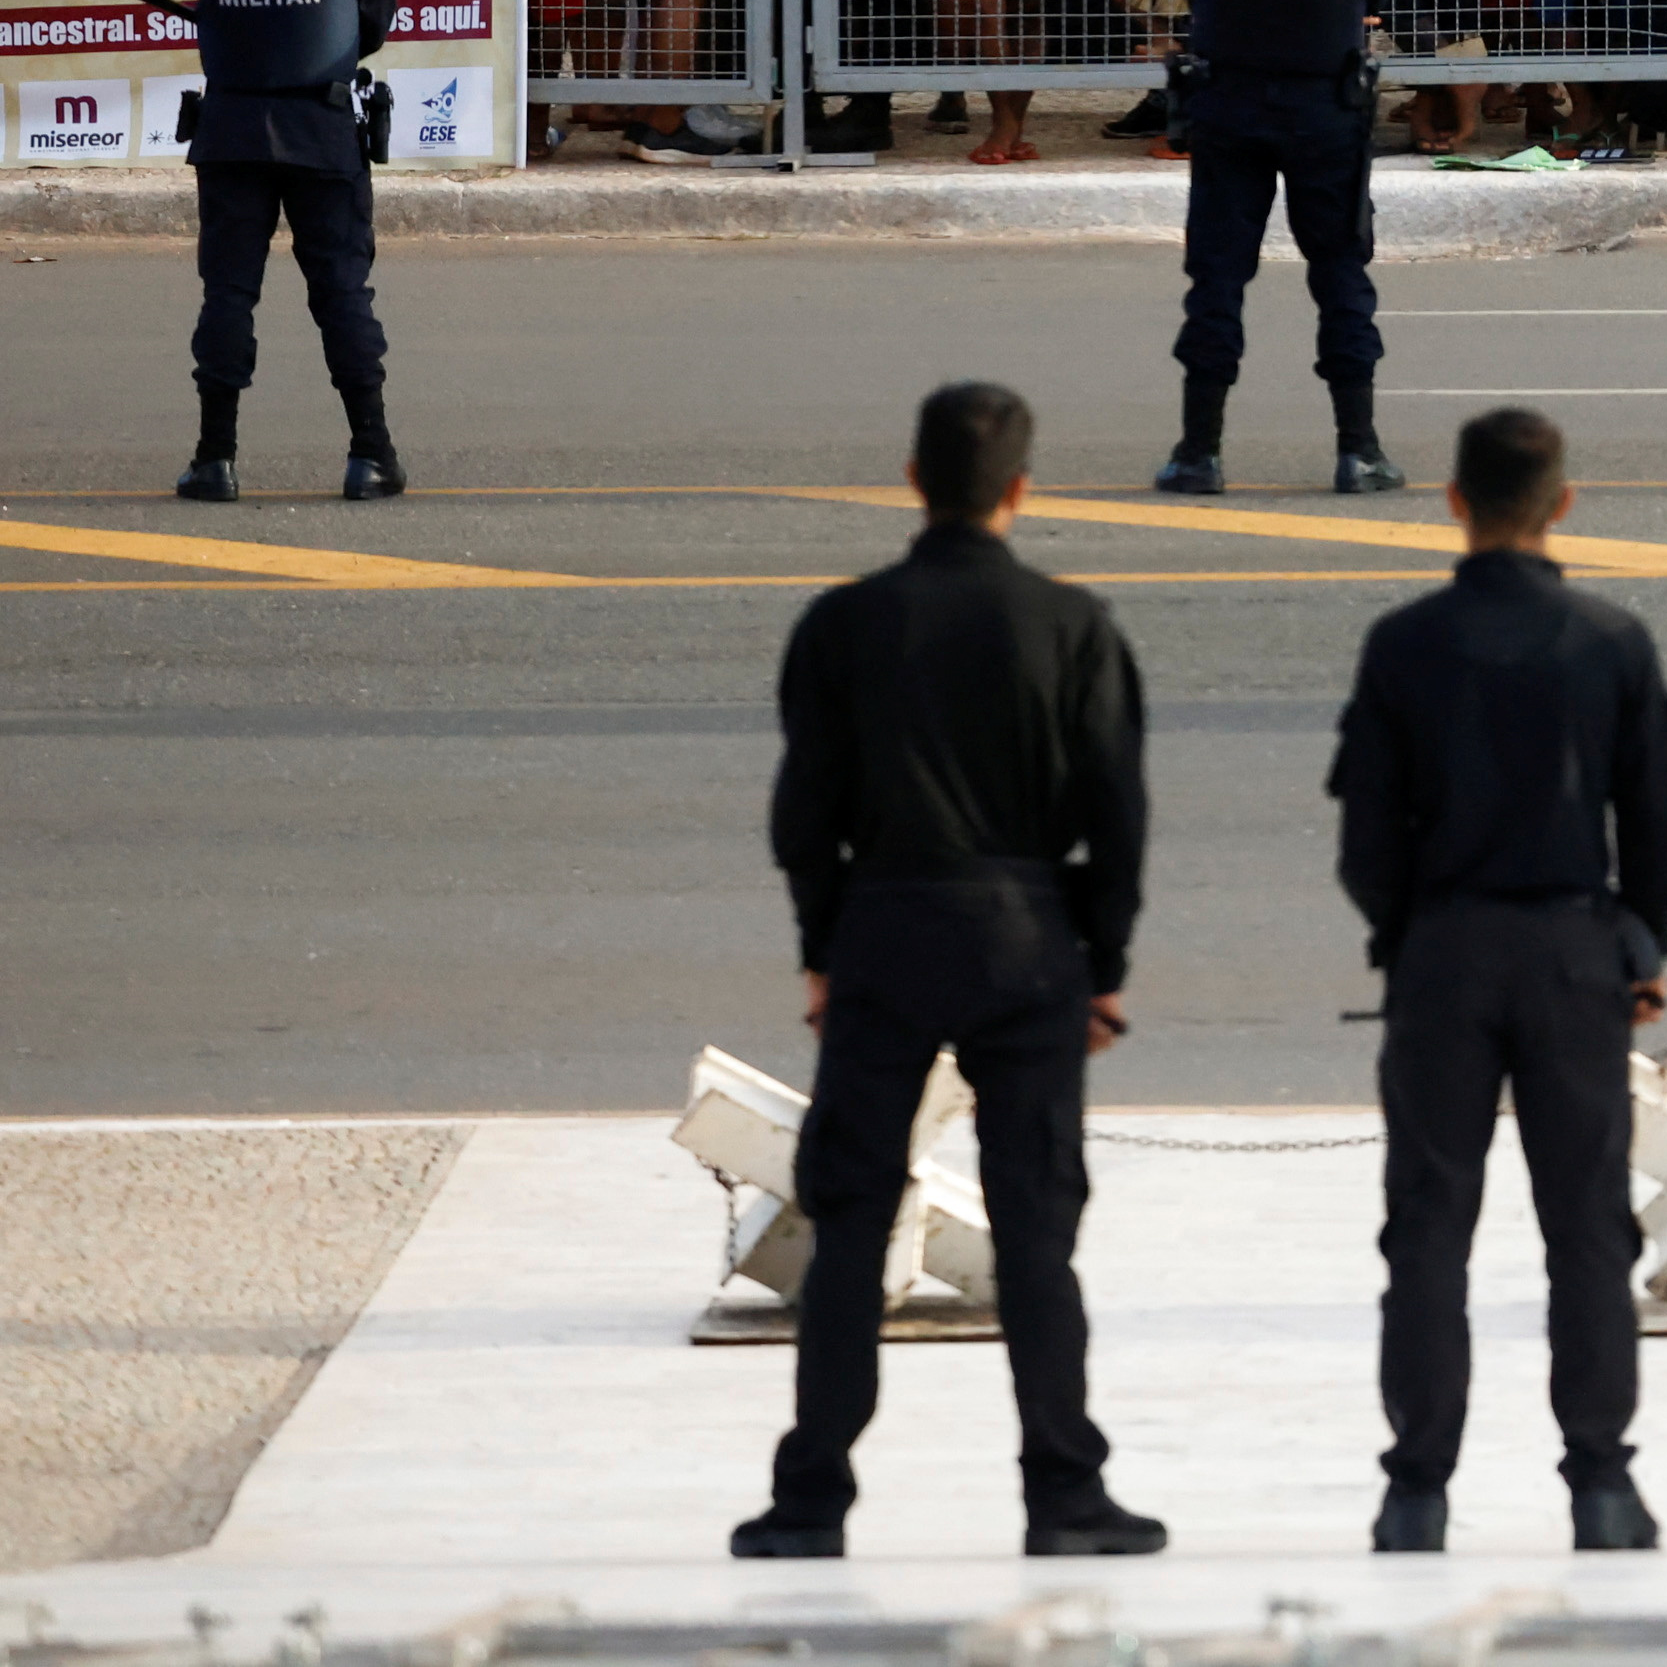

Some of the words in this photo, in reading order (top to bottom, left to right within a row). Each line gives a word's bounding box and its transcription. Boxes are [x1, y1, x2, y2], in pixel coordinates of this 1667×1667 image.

[0, 11, 142, 47] ancestral.
[419, 0, 488, 34] aqui.
[30, 129, 125, 150] misereor
[418, 125, 458, 143] CESE
